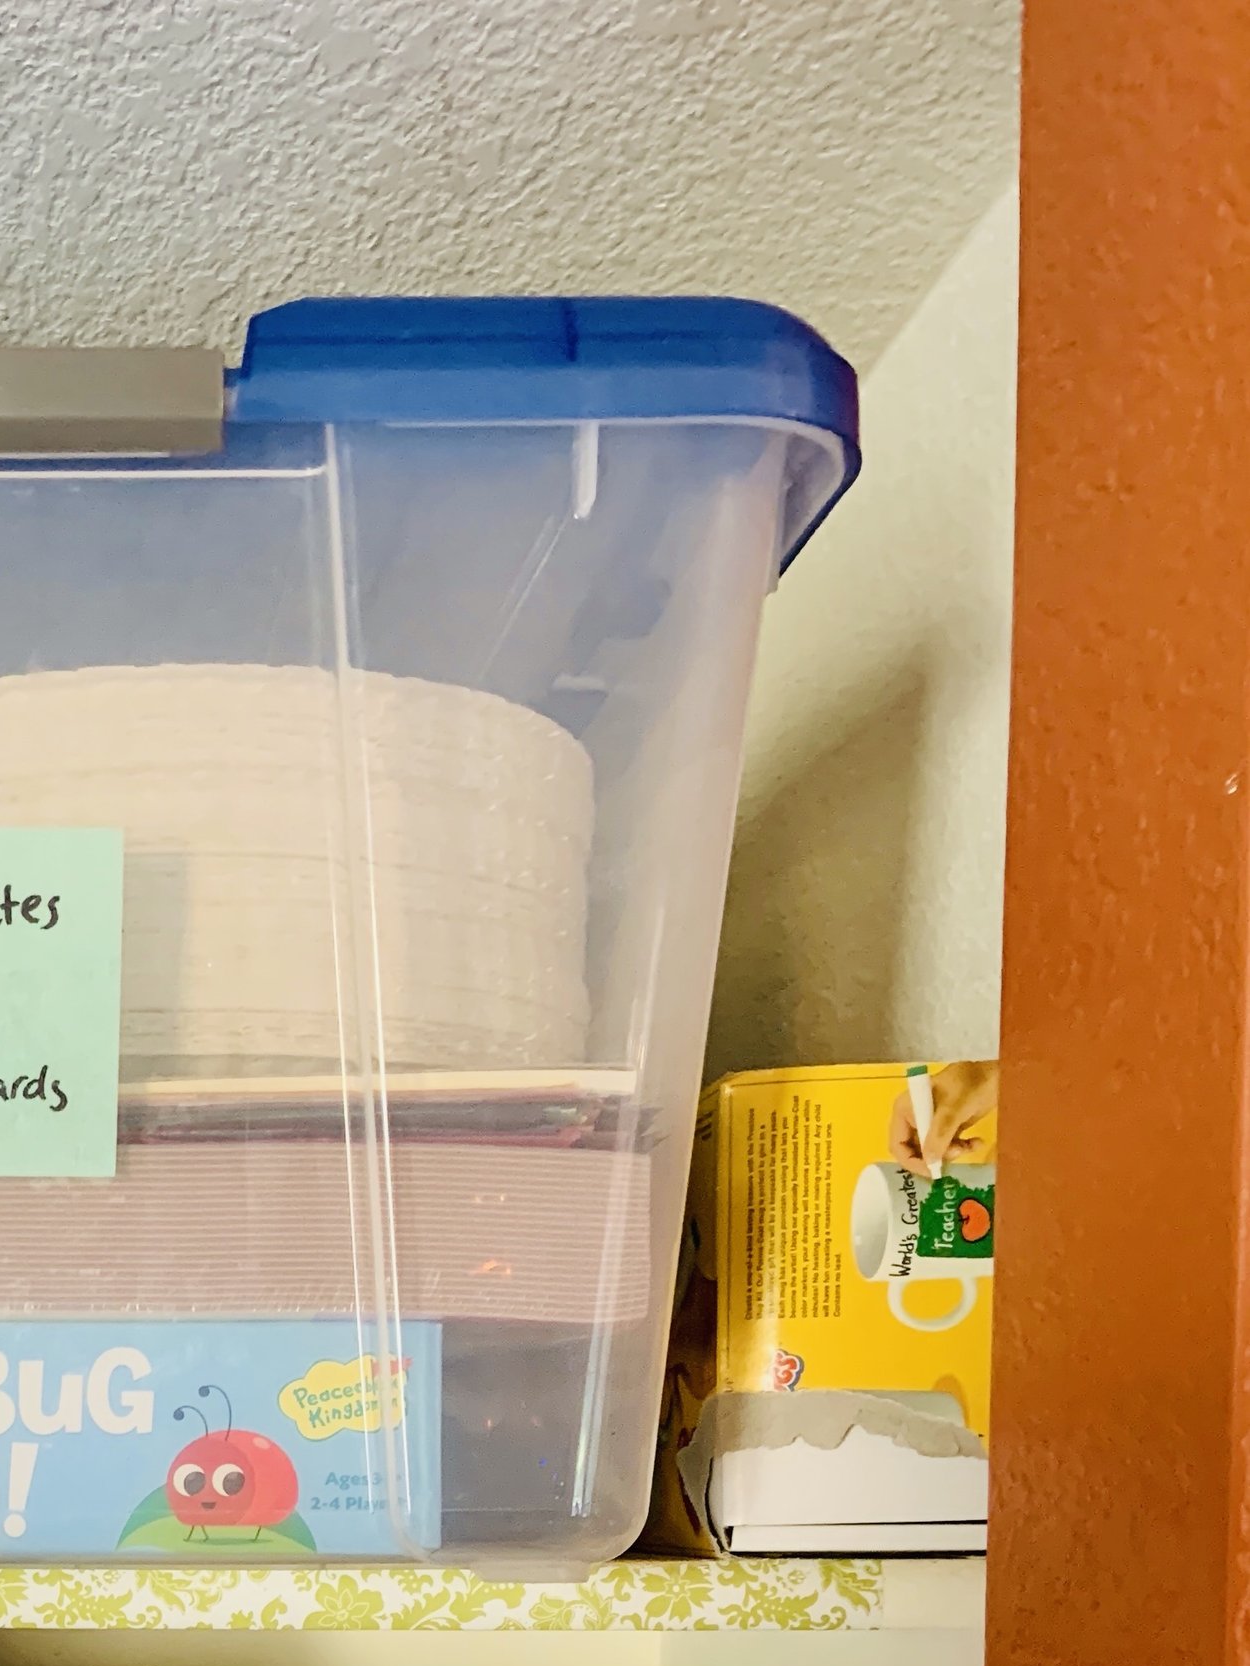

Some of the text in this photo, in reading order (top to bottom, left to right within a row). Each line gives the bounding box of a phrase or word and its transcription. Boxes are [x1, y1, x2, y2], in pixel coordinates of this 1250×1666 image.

[889, 1169, 919, 1277] World's Greatest
[931, 1182, 955, 1250] Teacher
[310, 1497, 341, 1510] 2-4
